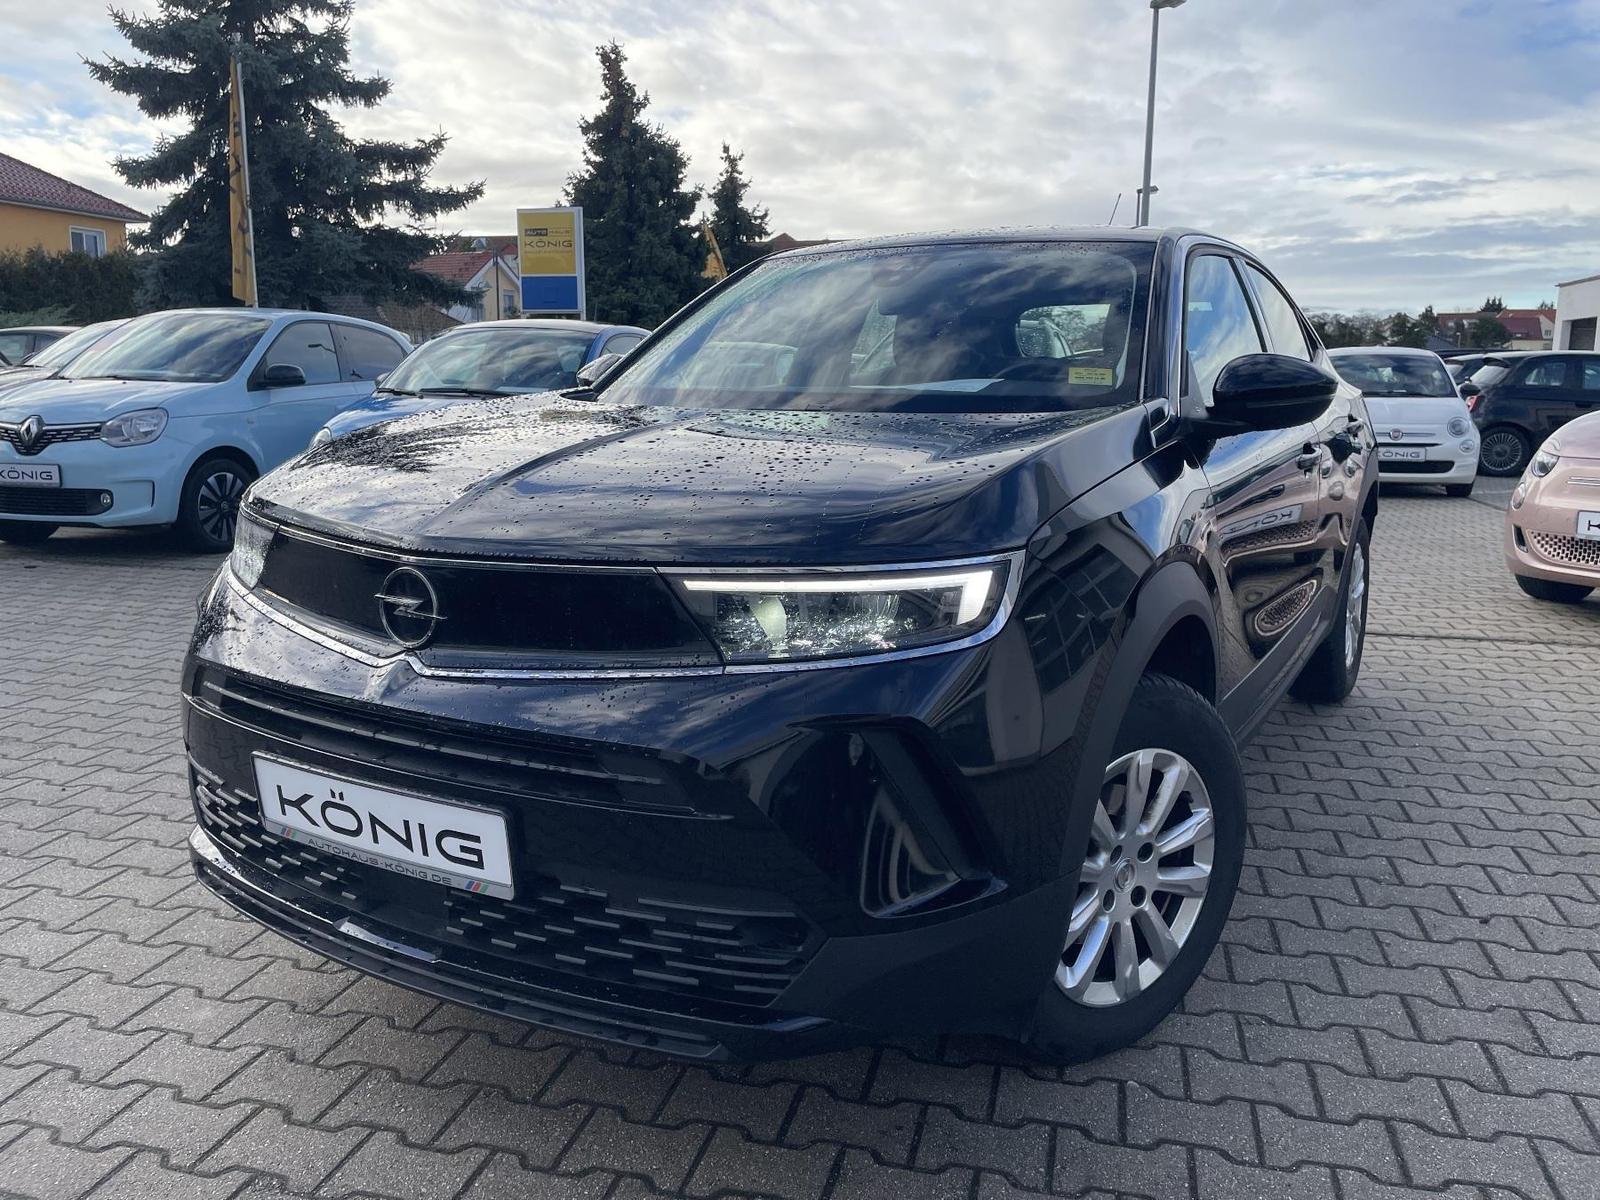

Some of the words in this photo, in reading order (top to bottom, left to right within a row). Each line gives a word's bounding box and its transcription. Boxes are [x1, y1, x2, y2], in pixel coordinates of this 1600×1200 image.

[524, 238, 573, 248] KÖNIG
[1379, 450, 1420, 459] ÖNIG
[276, 784, 485, 869] KÖNIG
